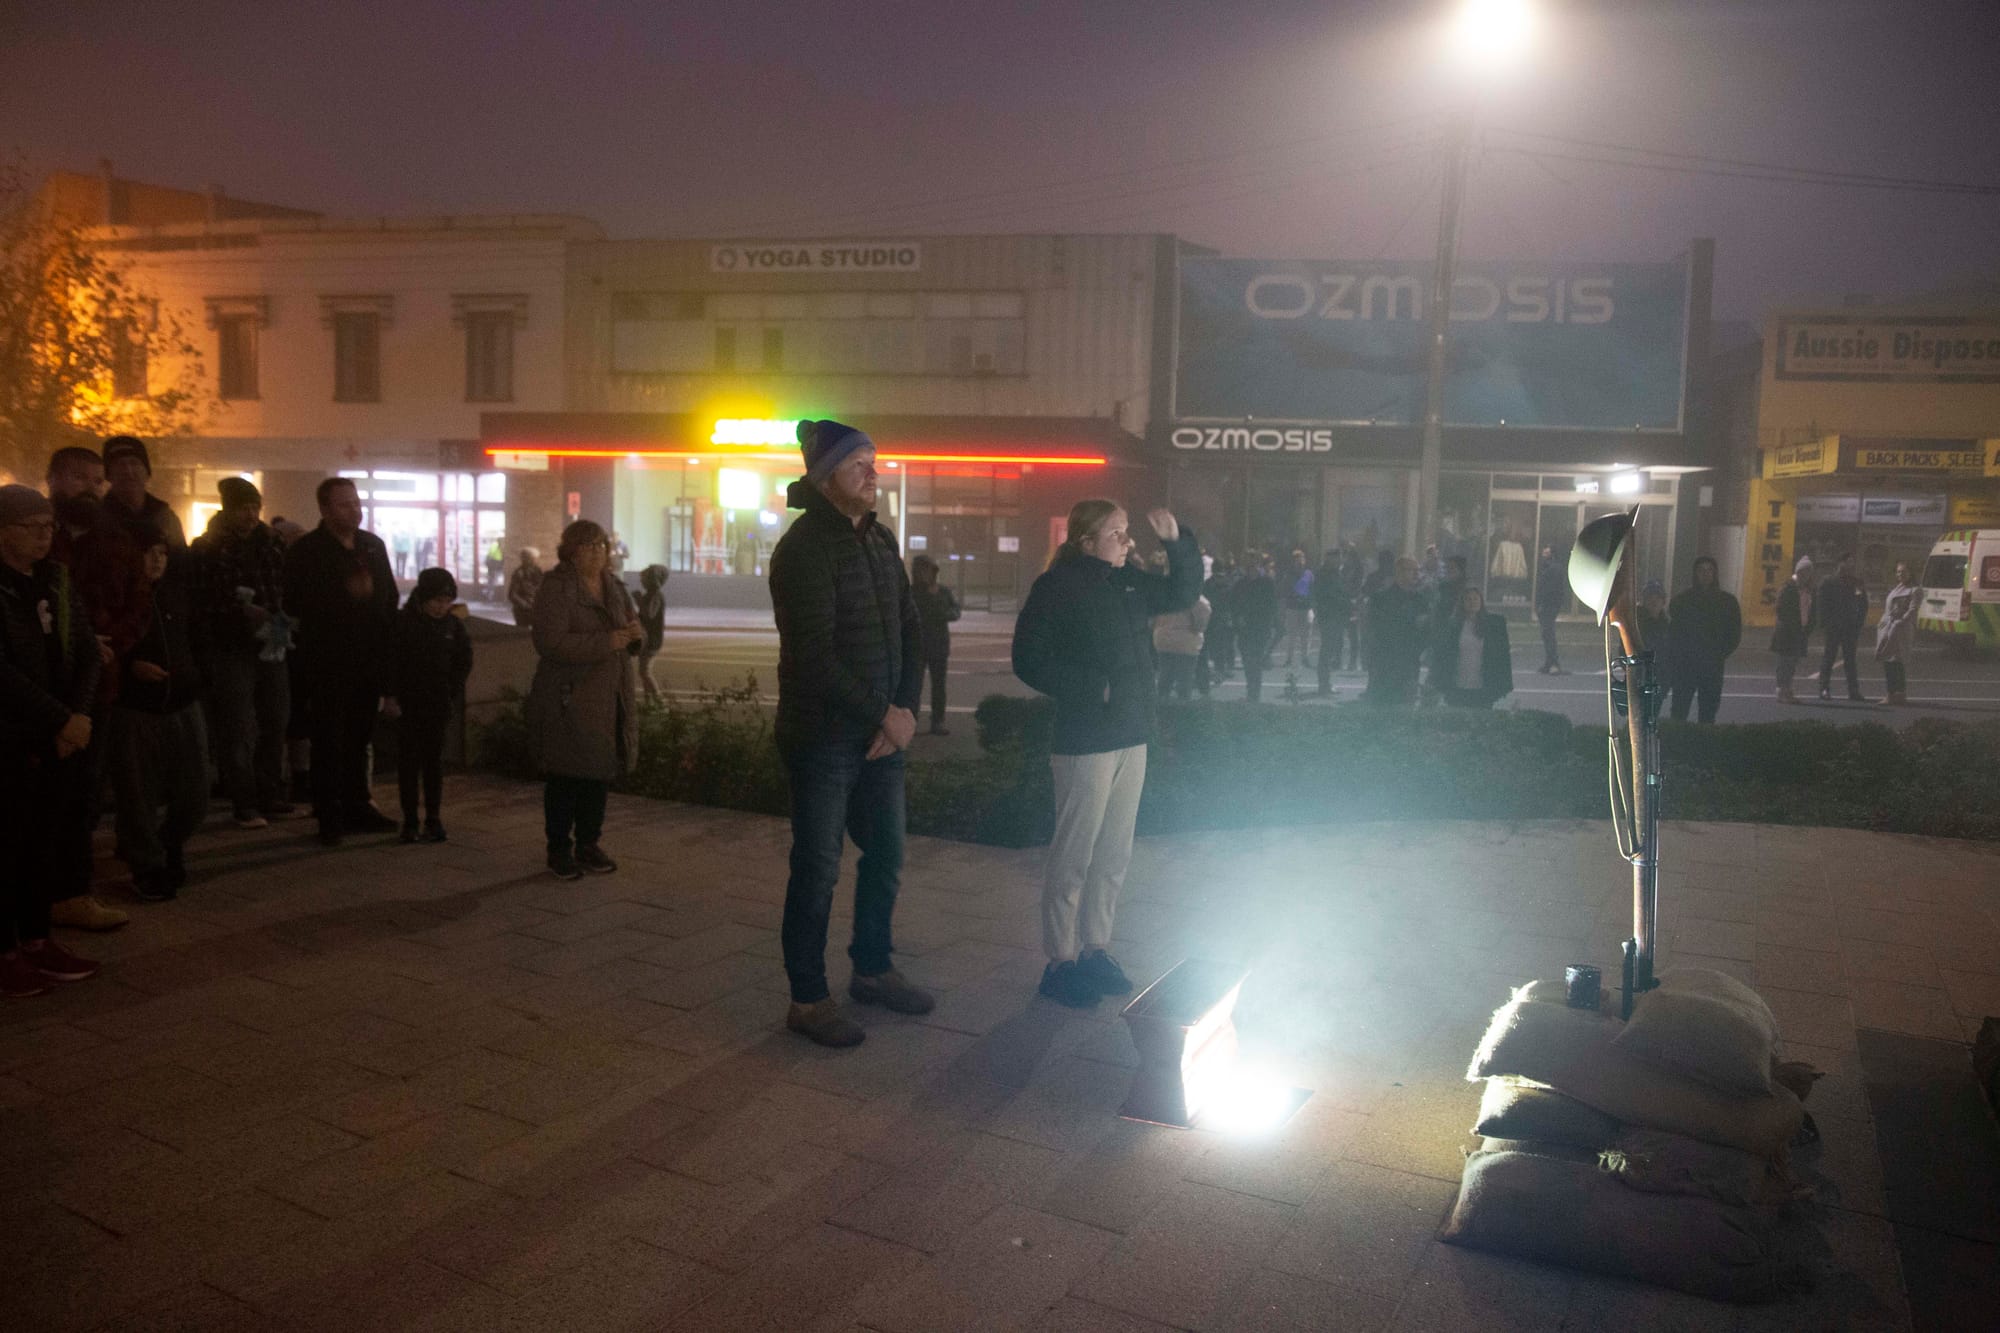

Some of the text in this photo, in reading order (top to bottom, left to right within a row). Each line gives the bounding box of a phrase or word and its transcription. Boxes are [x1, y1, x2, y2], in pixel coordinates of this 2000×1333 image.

[744, 248, 915, 267] YOGA STUDIO
[1245, 273, 1615, 325] OZMOSIS
[1793, 328, 1881, 359] Aussie
[1171, 428, 1333, 452] OZMOSIS
[1866, 452, 1899, 465] BACK
[1760, 500, 1785, 606] TENTS
